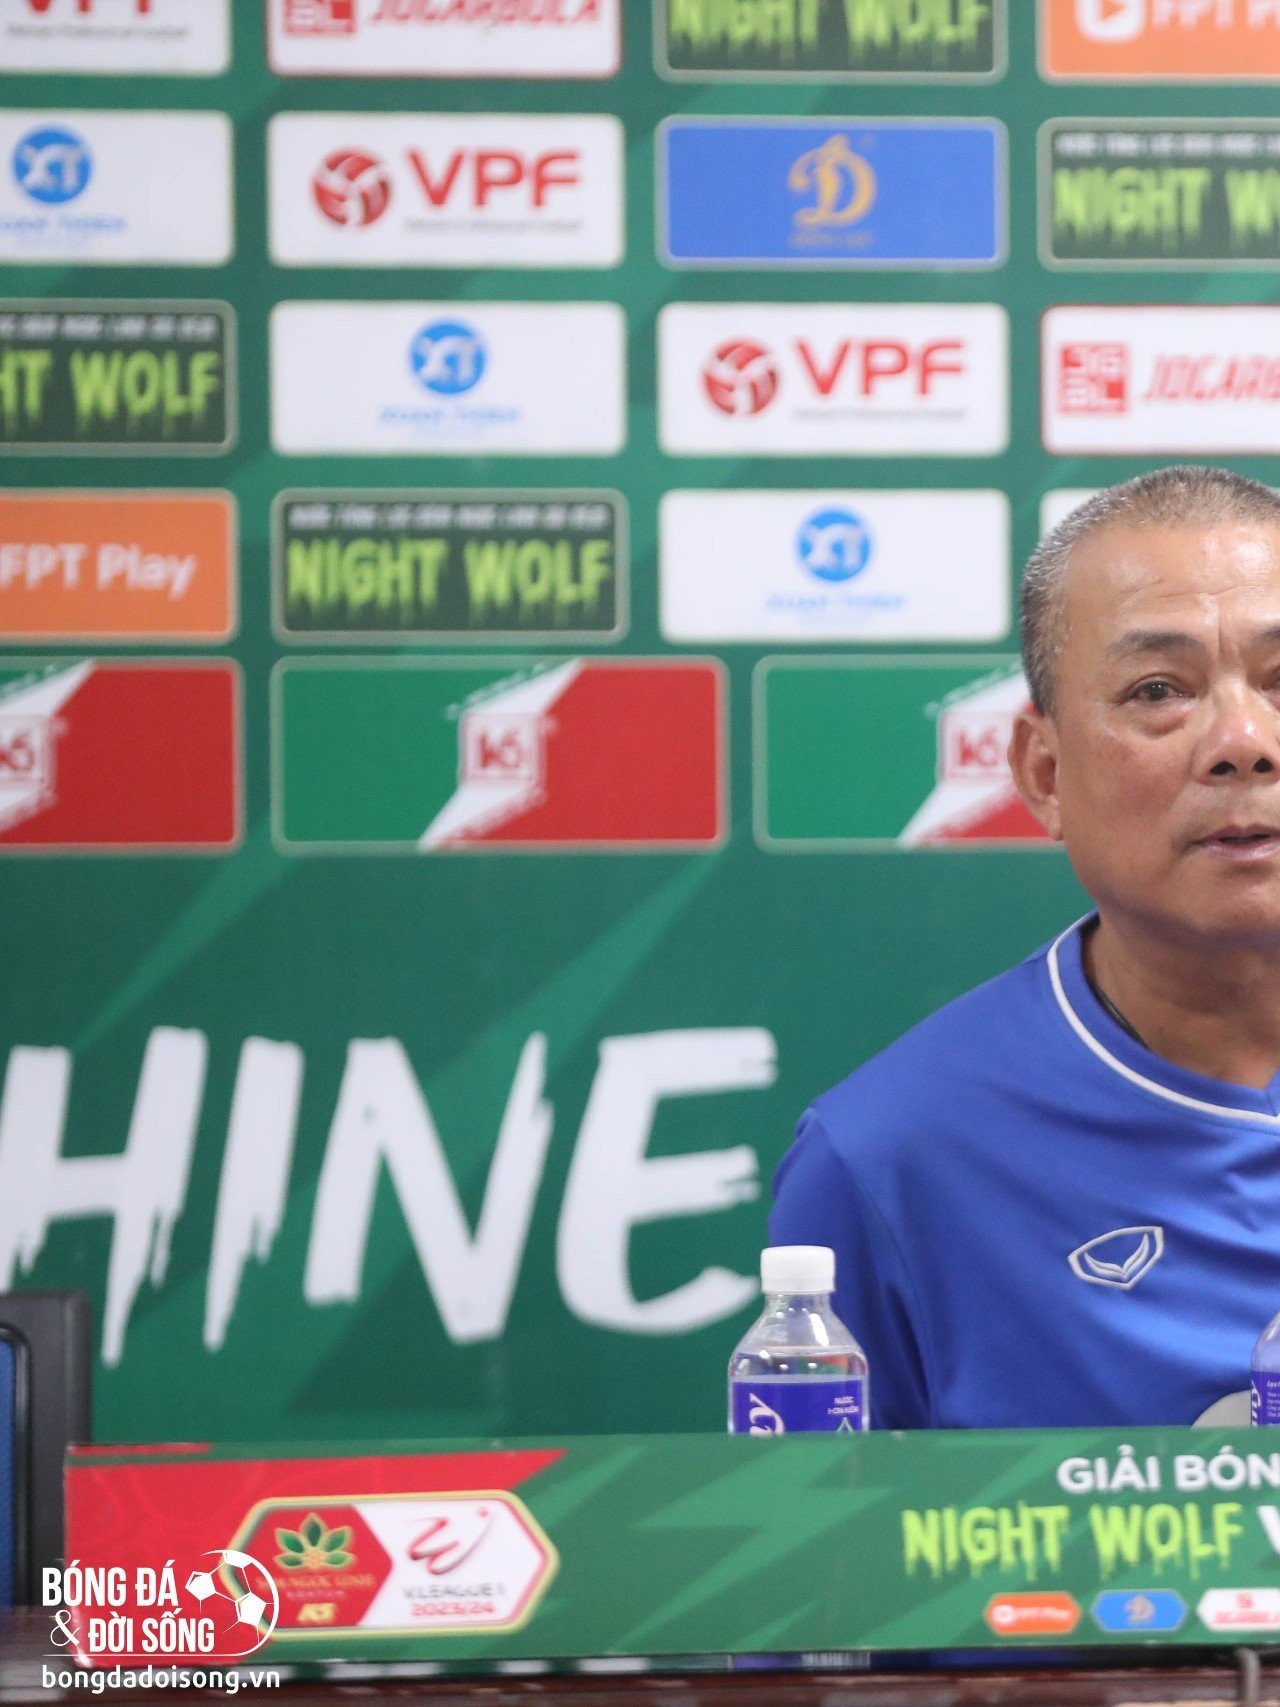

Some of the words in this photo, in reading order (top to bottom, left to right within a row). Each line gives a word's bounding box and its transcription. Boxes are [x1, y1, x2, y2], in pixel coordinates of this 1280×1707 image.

[406, 147, 582, 209] VPF
[1053, 166, 1212, 245] NIGHT
[69, 350, 221, 432] WOLF
[790, 338, 967, 397] VPF
[0, 543, 86, 588] FPT
[97, 544, 196, 600] Play
[288, 537, 448, 618] NIGHT
[464, 537, 612, 620] WOLF
[1057, 1443, 1162, 1494] GIẢI
[902, 1502, 1070, 1580] NIGHT
[1089, 1502, 1244, 1578] WOLF
